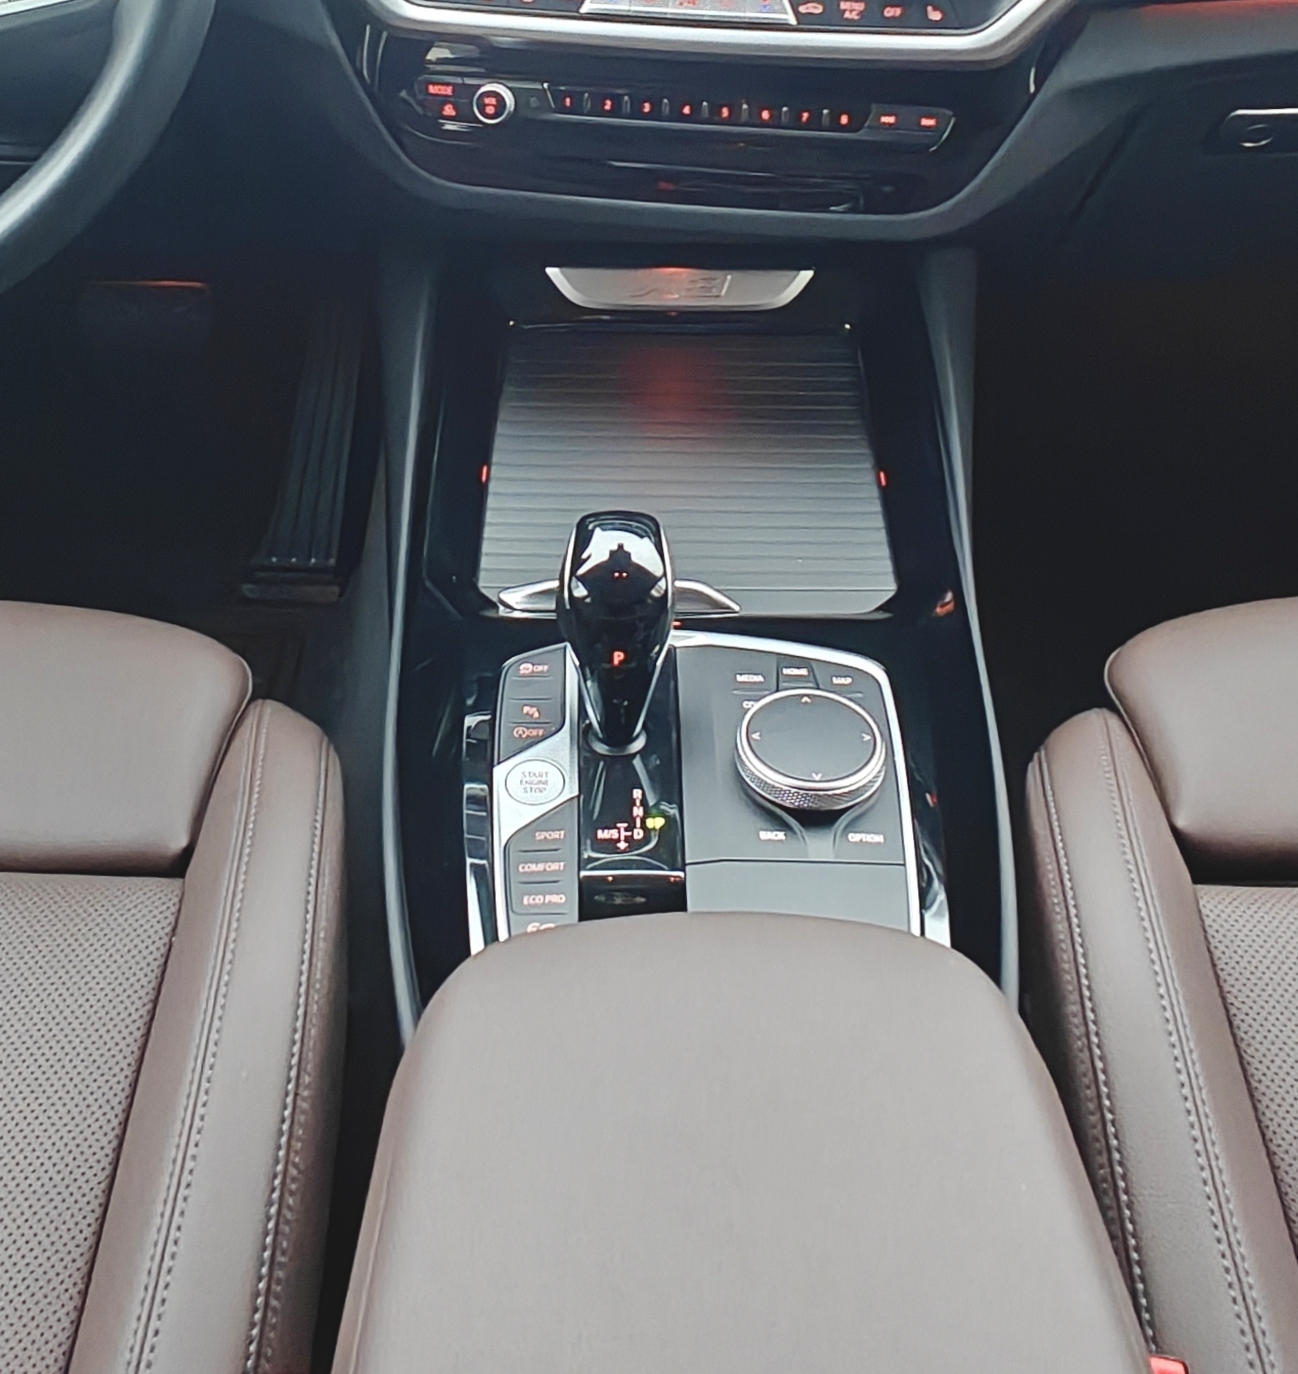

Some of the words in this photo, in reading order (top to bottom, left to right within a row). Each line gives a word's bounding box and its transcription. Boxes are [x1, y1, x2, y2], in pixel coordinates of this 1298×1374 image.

[564, 97, 571, 107] 1
[603, 99, 612, 110] 2
[642, 101, 651, 113] 3
[681, 104, 691, 115] 4
[801, 112, 810, 123] 7
[613, 651, 625, 667] P
[527, 728, 545, 737] OFF
[535, 830, 565, 840] SPORT
[633, 829, 644, 839] D
[759, 830, 786, 840] BACK
[518, 862, 566, 873] COMFORT
[523, 894, 544, 905] ECO
[545, 894, 566, 904] PRO
